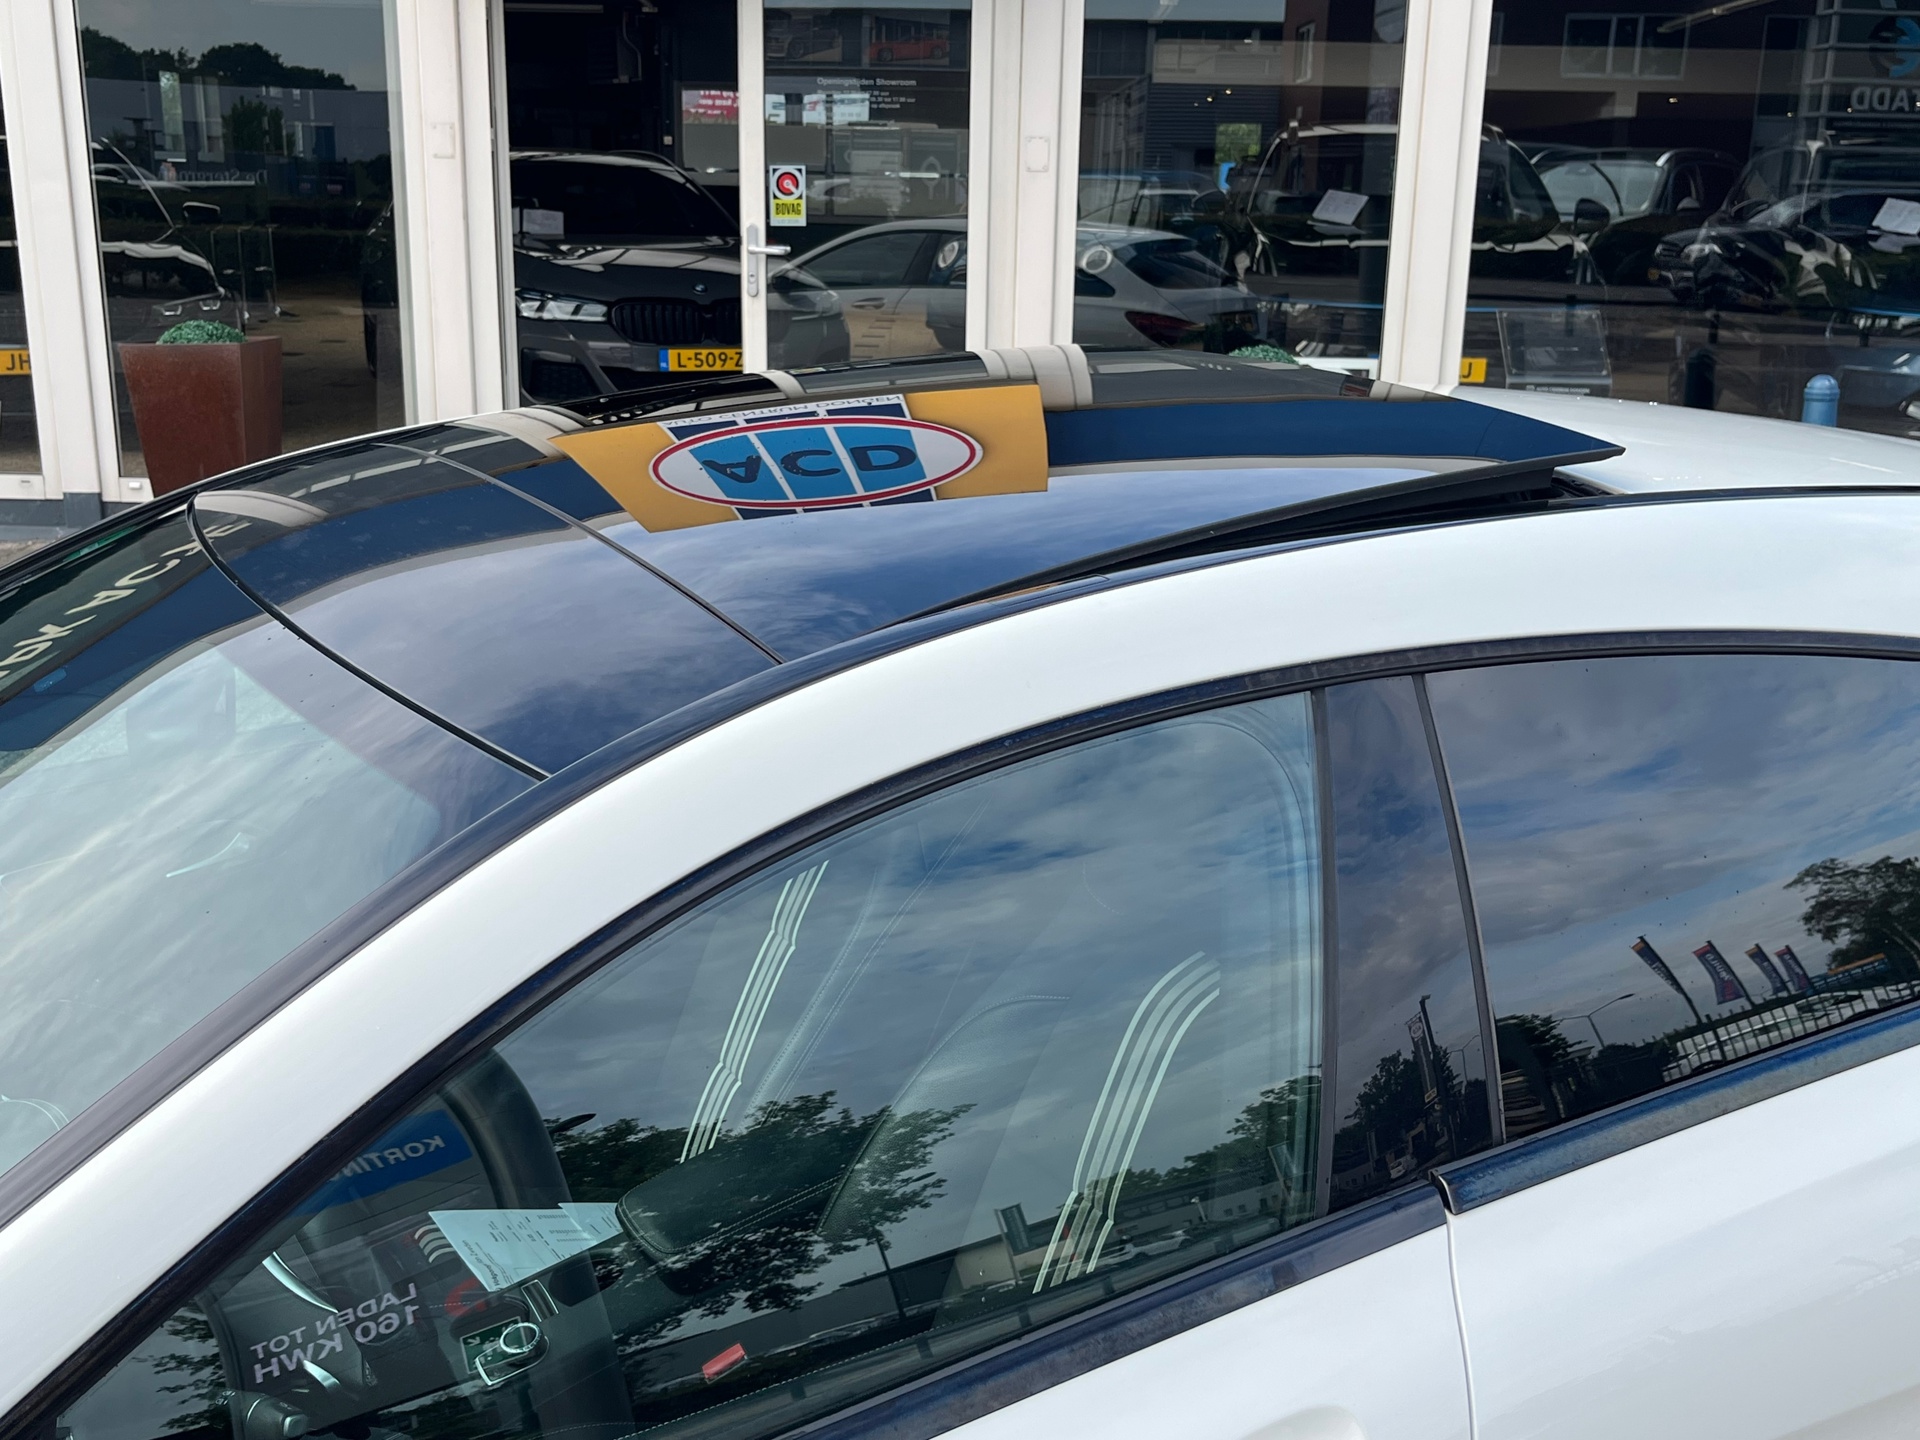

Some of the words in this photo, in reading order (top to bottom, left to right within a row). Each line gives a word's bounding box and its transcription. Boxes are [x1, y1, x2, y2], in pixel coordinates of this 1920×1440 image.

[876, 78, 917, 86] Showroom
[775, 202, 802, 216] BOVAG
[677, 351, 743, 368] L-509-Z
